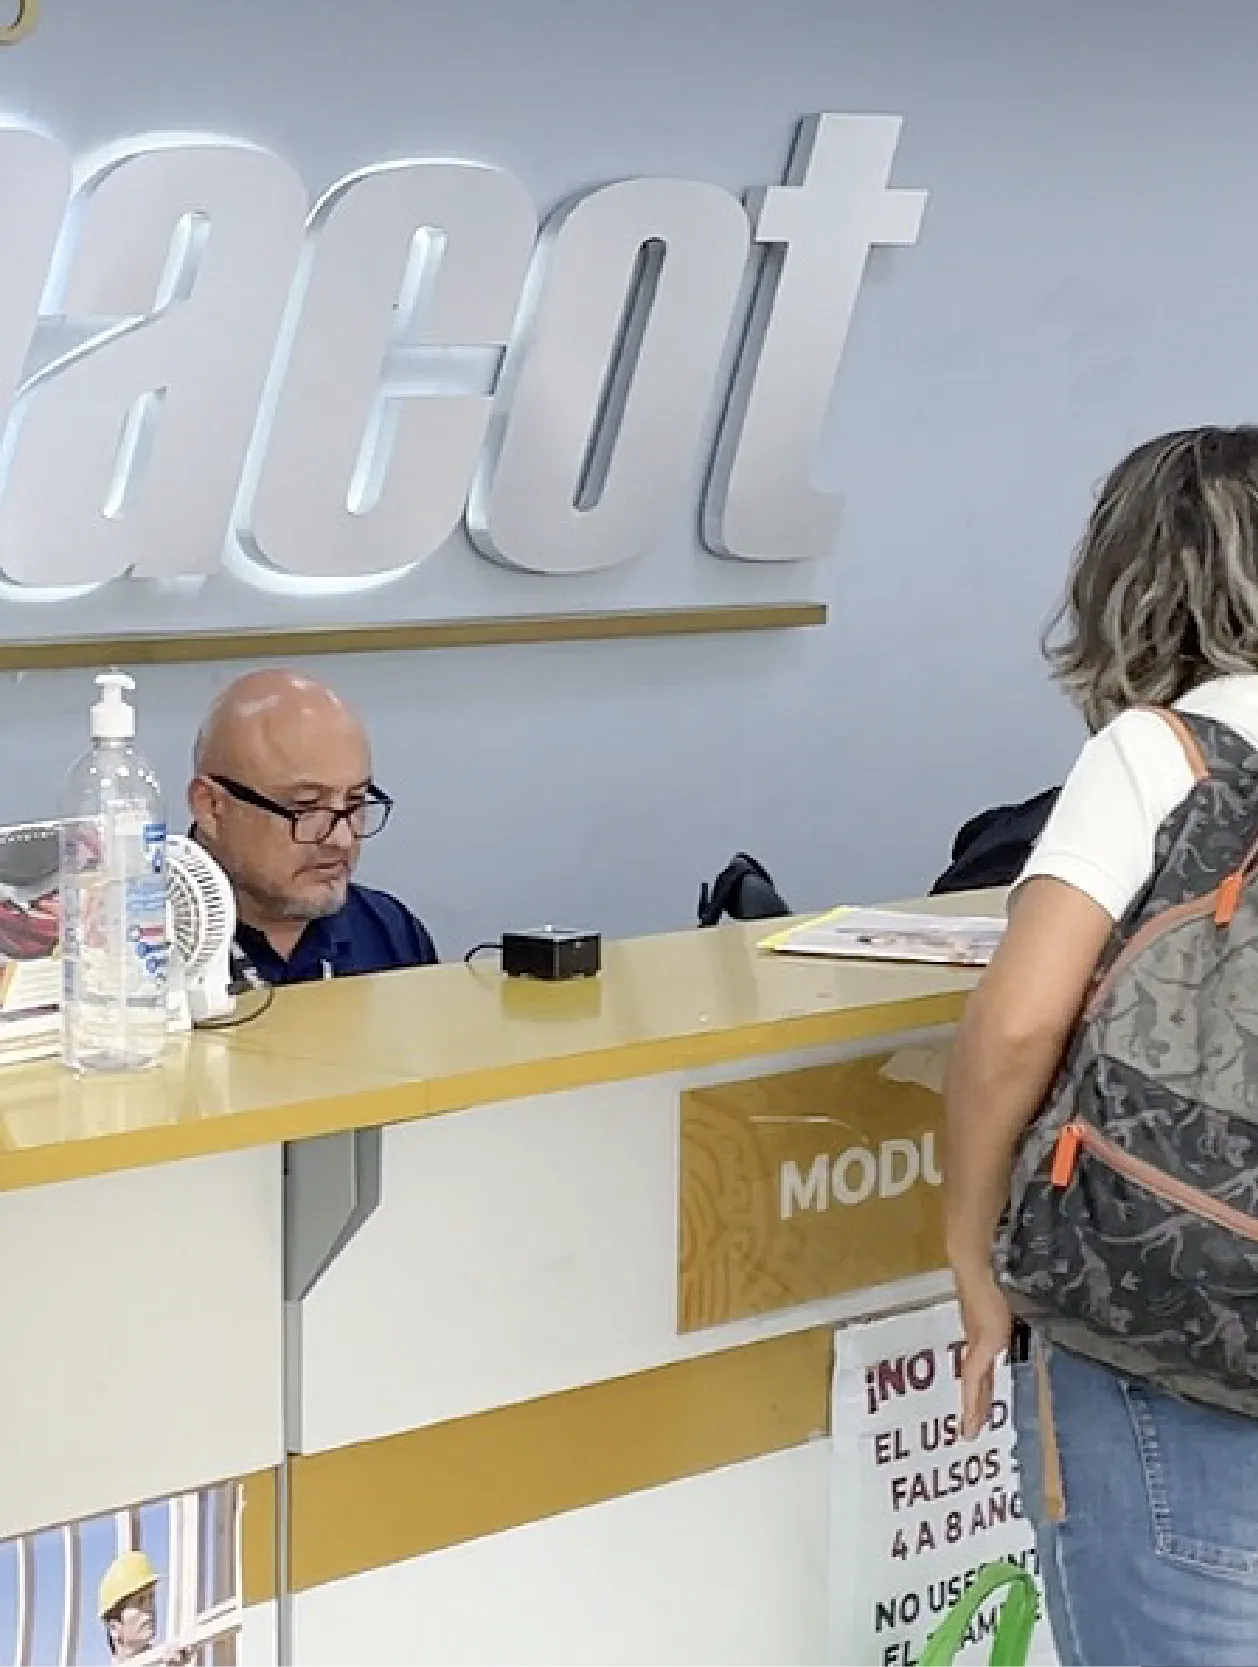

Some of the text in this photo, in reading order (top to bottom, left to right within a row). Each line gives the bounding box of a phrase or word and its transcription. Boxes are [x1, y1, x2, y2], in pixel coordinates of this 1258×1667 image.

[0, 112, 930, 586] acot
[866, 1347, 936, 1415] ¡NO
[875, 1429, 911, 1465] EL
[892, 1448, 1001, 1512] FALSOS
[891, 1528, 908, 1561] 4
[916, 1520, 936, 1555] A
[946, 1511, 963, 1544] 8
[875, 1592, 921, 1634] NO
